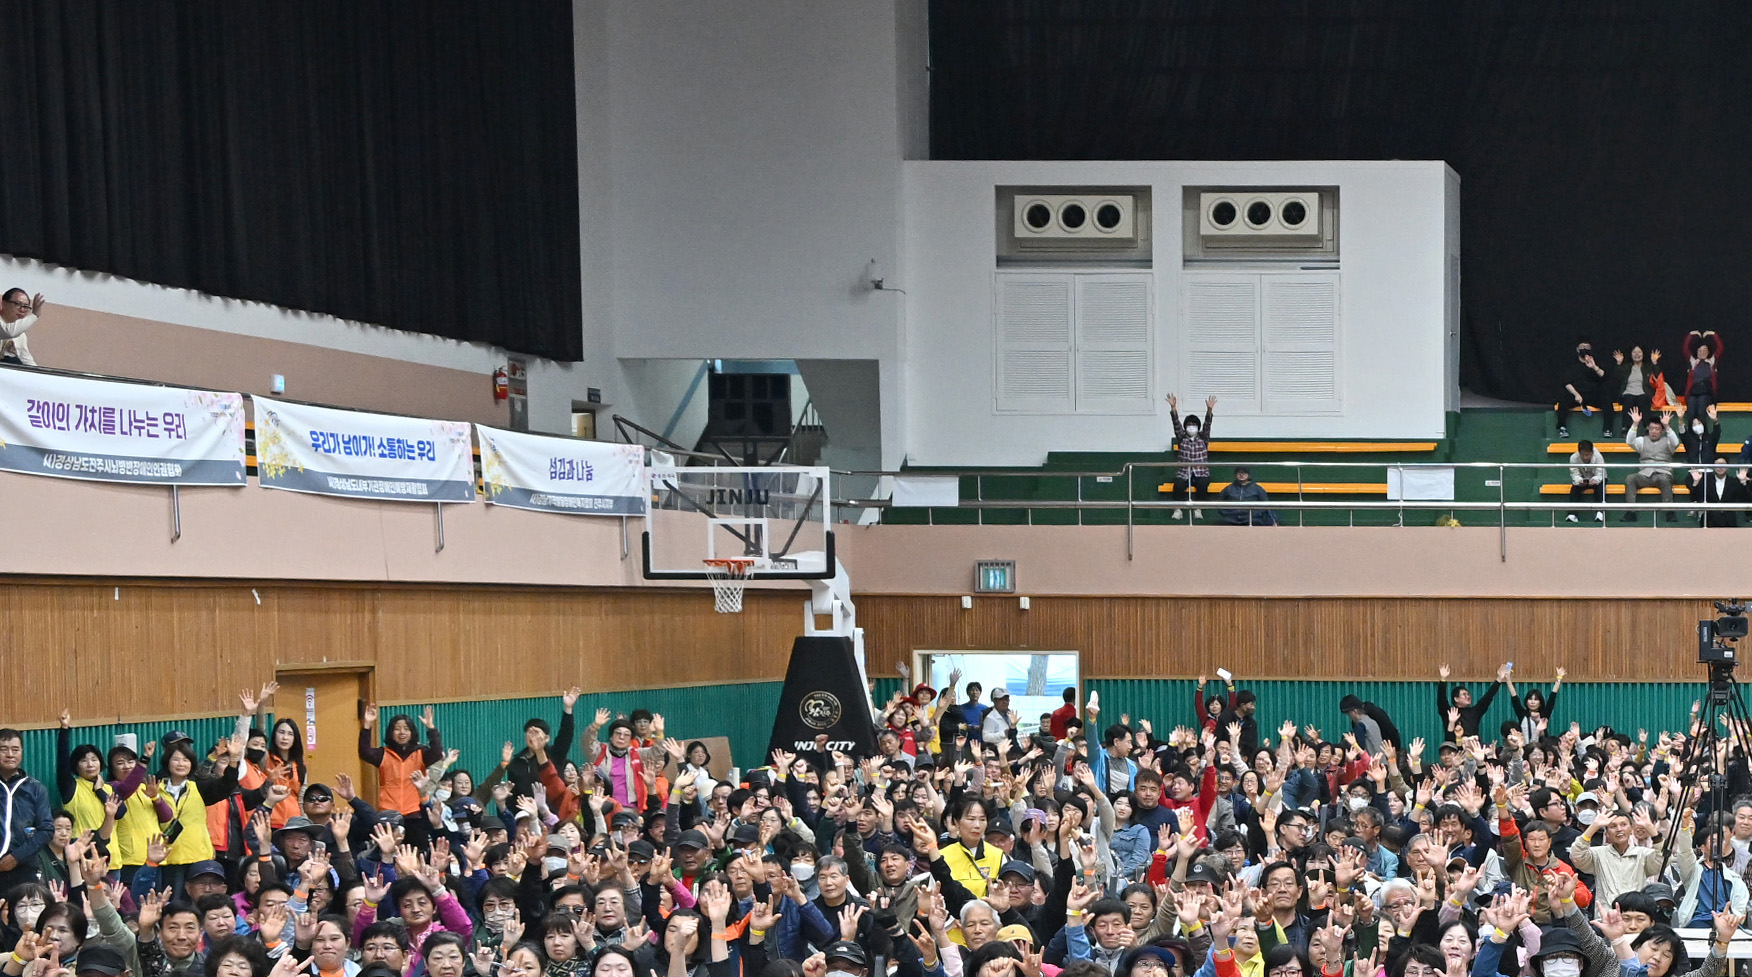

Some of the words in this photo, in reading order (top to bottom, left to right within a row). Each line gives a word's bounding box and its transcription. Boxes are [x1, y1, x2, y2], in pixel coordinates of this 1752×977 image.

[27, 399, 71, 432] 같이의
[75, 403, 116, 436] 가치를
[120, 408, 160, 438] 나누는
[163, 411, 187, 440] 우리
[309, 430, 342, 455] 우리가
[342, 434, 376, 458] 남이가!
[378, 437, 416, 461] 소통하는
[417, 440, 436, 462] 우리
[549, 457, 575, 481] 섬김과
[576, 459, 594, 482] 나눔
[706, 489, 769, 505] JINJU
[825, 741, 856, 751] CITY
